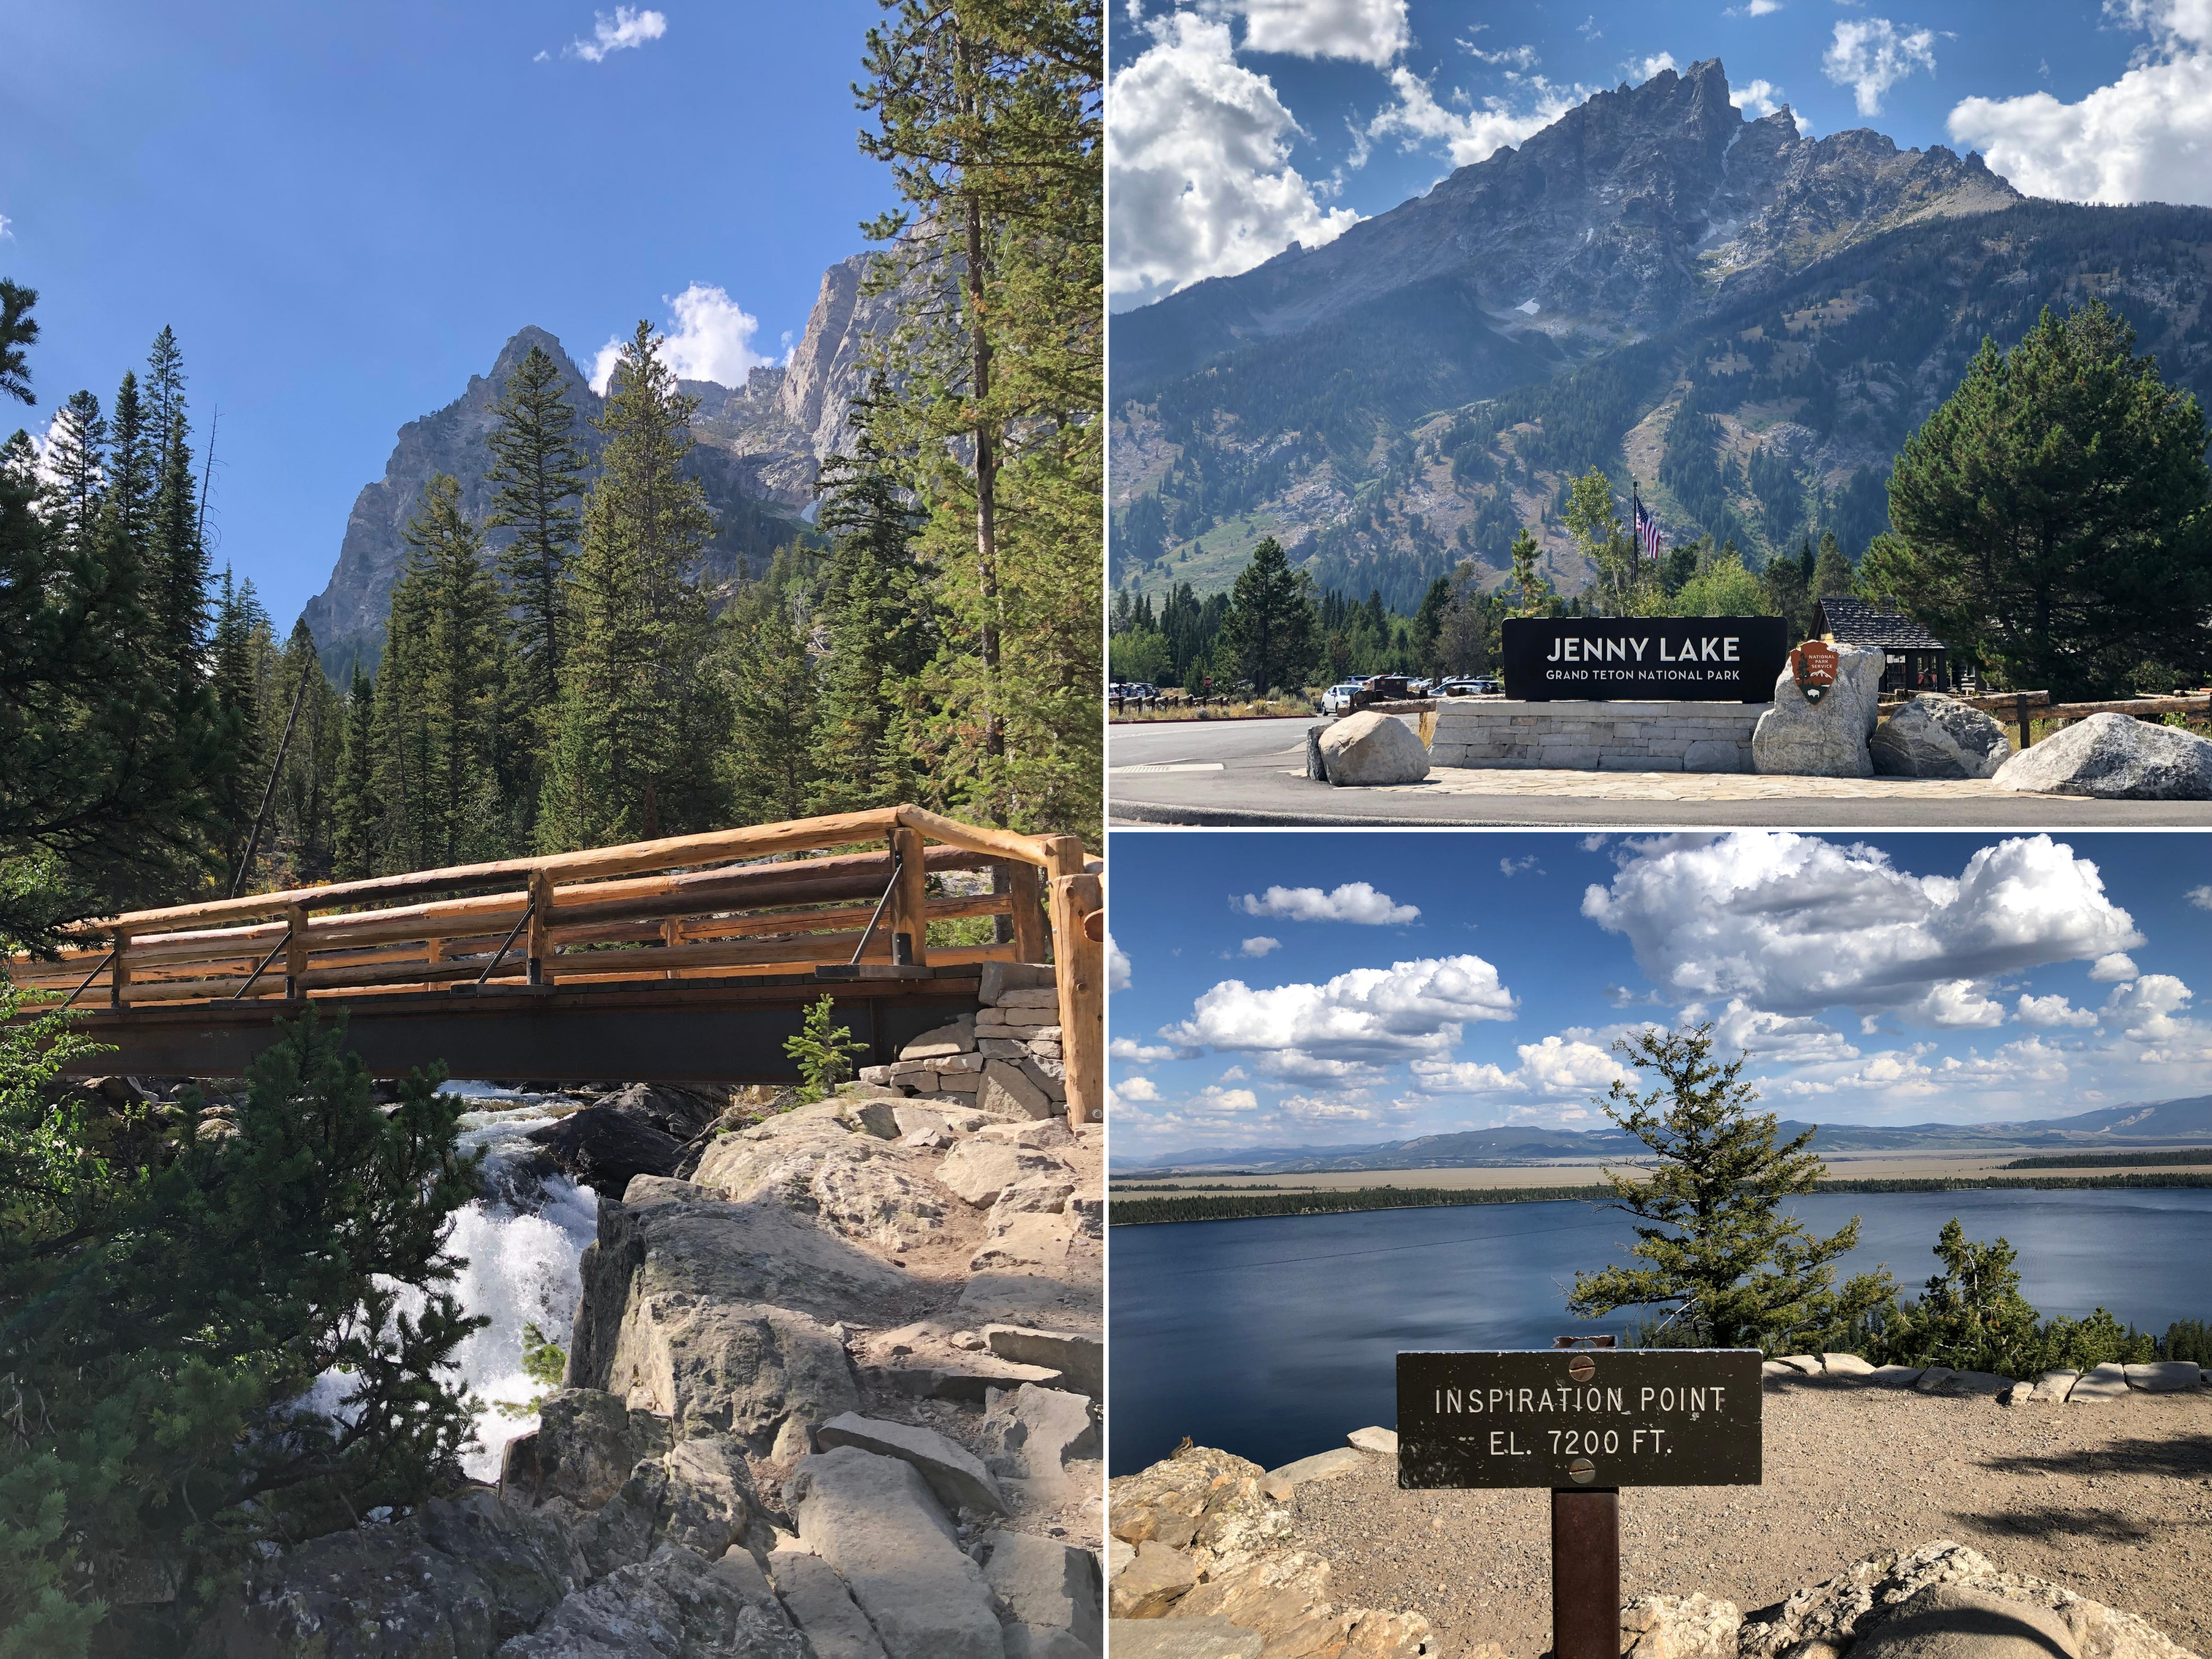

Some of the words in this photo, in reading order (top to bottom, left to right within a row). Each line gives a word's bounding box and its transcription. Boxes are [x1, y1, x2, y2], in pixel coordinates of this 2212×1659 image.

[1547, 637, 1649, 662] JENNY
[1661, 637, 1740, 662] LAKE
[1546, 670, 1588, 680] GRAND
[1592, 670, 1634, 680] TETON
[1639, 670, 1703, 680] NATIONAL
[1707, 670, 1740, 680] PARK
[1436, 1387, 1622, 1414] INSPIRATION
[1641, 1386, 1725, 1412] POINT
[1490, 1431, 1532, 1456] EL.
[1548, 1430, 1618, 1455] 7200
[1633, 1429, 1672, 1455] FT.
